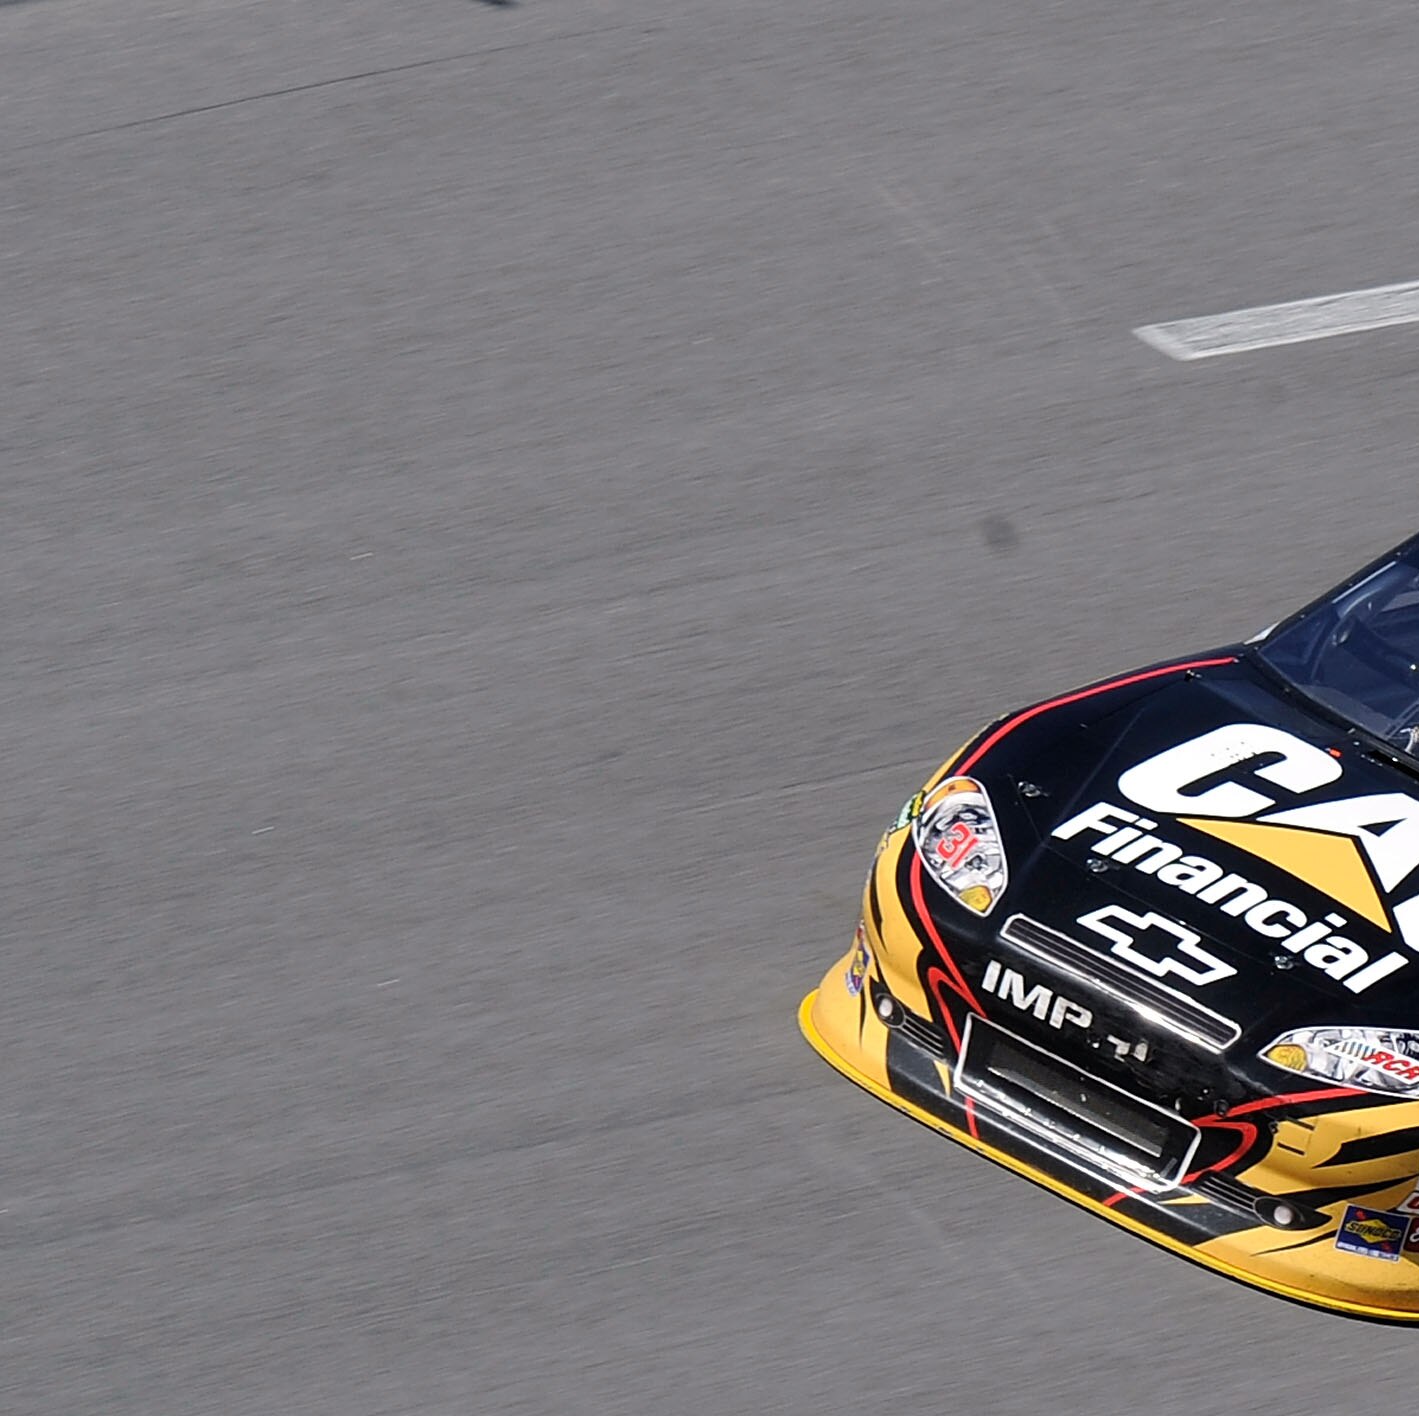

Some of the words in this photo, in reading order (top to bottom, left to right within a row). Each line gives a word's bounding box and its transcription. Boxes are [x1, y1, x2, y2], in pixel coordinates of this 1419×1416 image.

[936, 821, 979, 871] 31
[1051, 802, 1410, 994] Financial
[1349, 1221, 1400, 1243] SUNOCO
